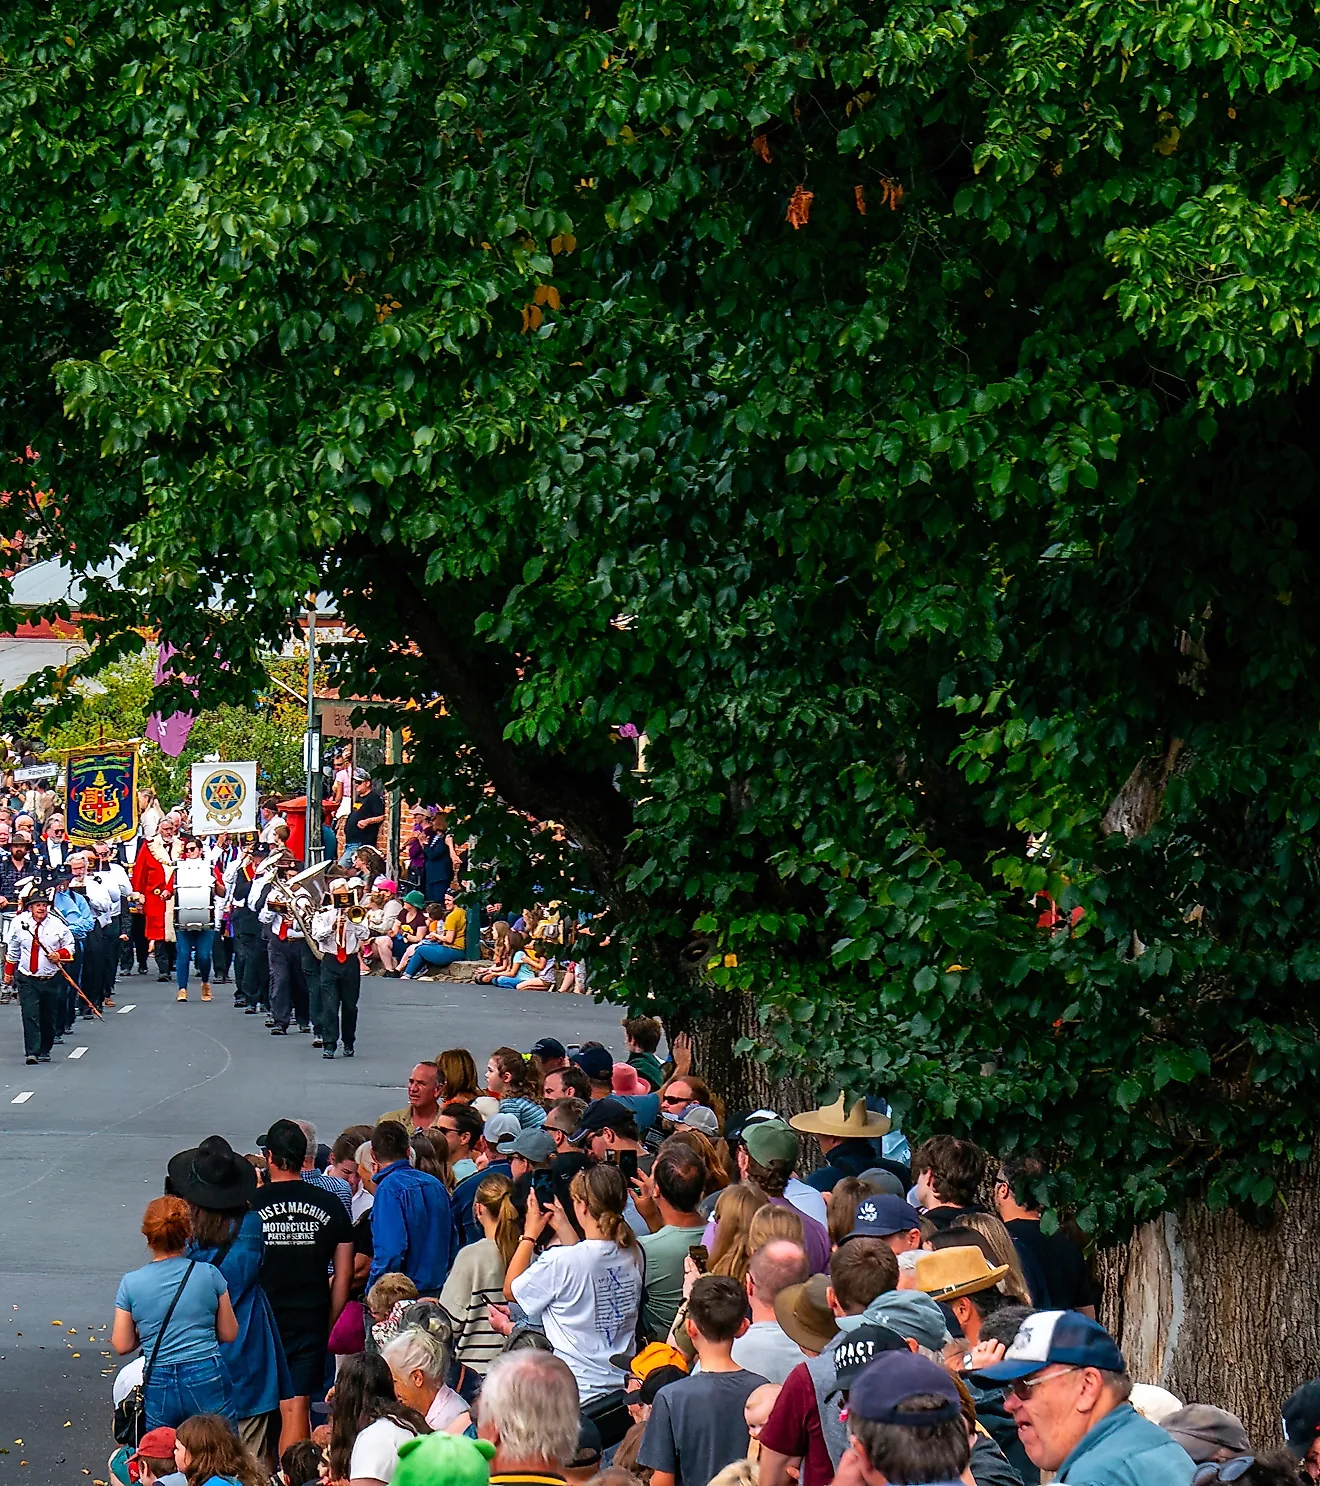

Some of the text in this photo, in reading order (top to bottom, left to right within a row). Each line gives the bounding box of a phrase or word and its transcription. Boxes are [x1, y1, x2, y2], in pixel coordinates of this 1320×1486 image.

[258, 1201, 332, 1226] US EX MACHINA
[262, 1221, 320, 1233] MOTORCYCLES
[267, 1232, 286, 1240] PARTS
[291, 1232, 315, 1240] SERVICE
